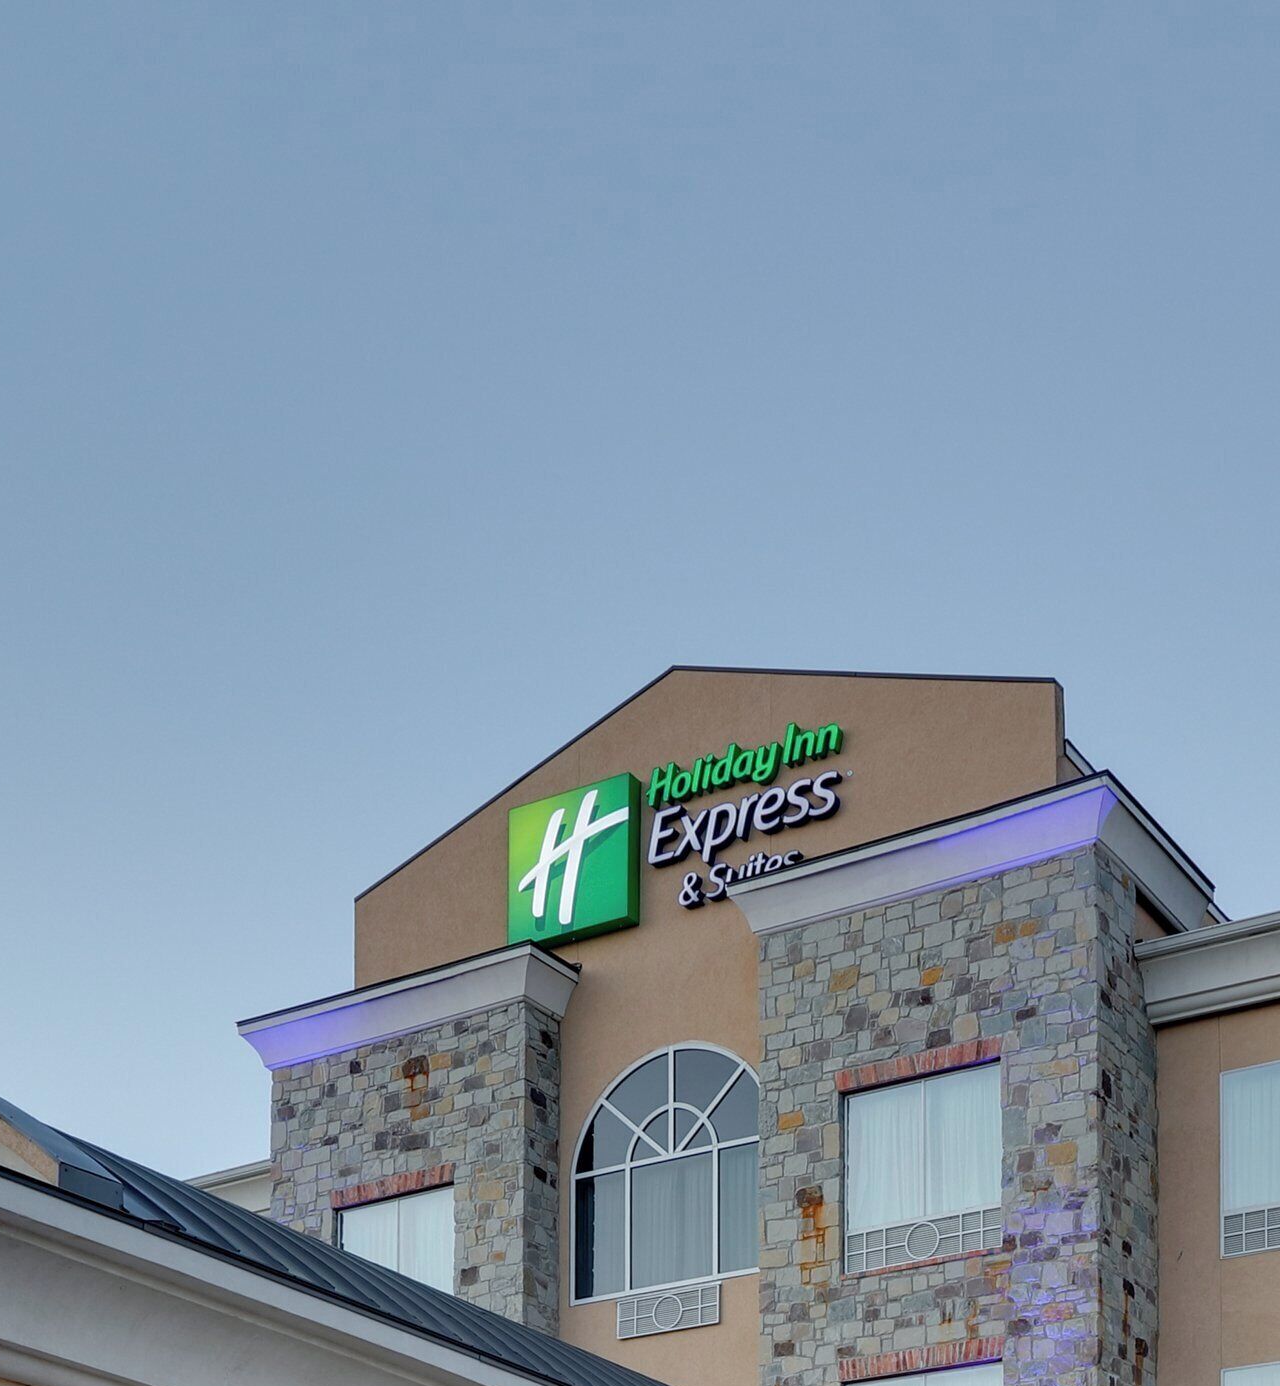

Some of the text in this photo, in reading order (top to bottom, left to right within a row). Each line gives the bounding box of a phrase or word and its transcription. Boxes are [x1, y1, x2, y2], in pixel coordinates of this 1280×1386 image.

[646, 722, 843, 809] Holiday Inn
[648, 770, 841, 867] Express
[678, 871, 704, 908] &
